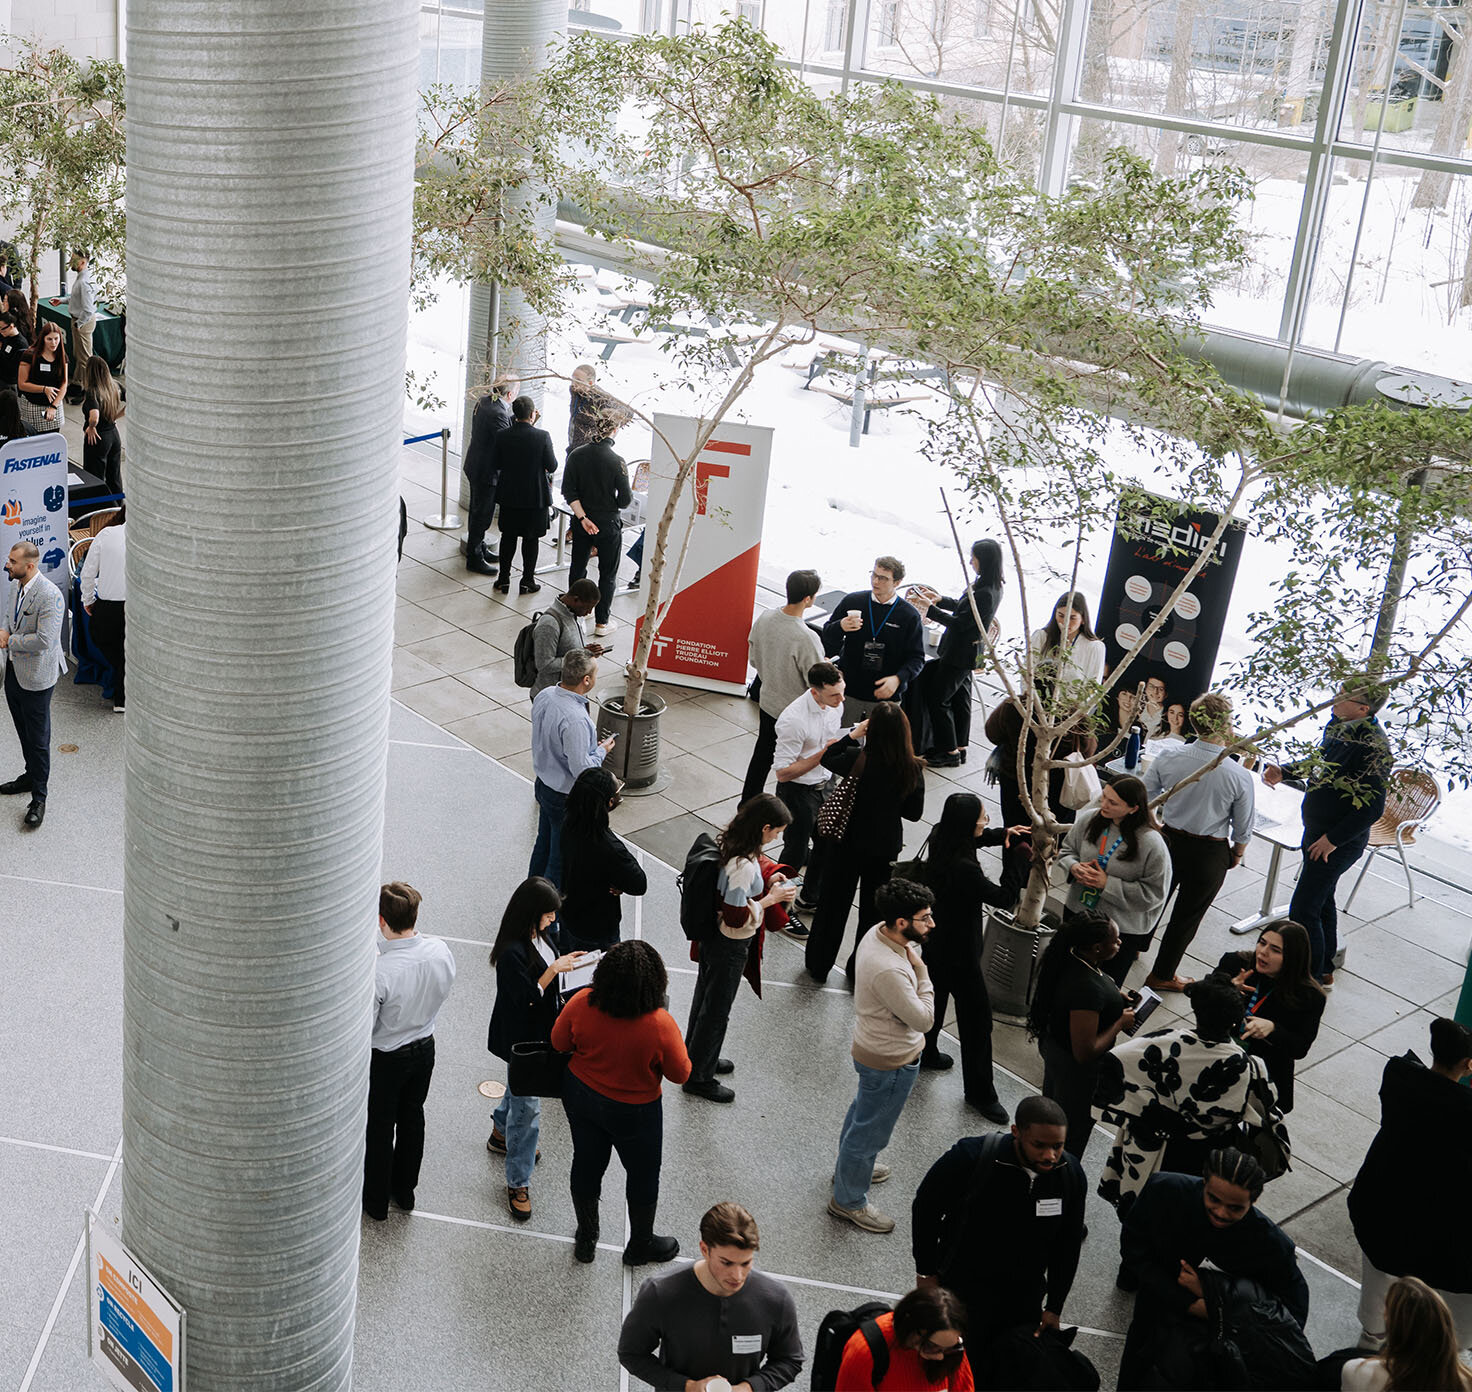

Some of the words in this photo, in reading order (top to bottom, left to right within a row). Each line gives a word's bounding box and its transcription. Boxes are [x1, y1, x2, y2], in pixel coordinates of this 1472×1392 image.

[3, 452, 62, 474] FASTENAL
[22, 515, 47, 527] imagine
[18, 524, 43, 539] yourself
[44, 524, 51, 532] in
[676, 639, 716, 650] FONDATION
[676, 644, 700, 653] PIERRE
[701, 648, 728, 658] ELLIOTT
[675, 649, 708, 660] TRUDEAU
[675, 655, 719, 667] FOUNDATION
[129, 1270, 142, 1294] ICI
